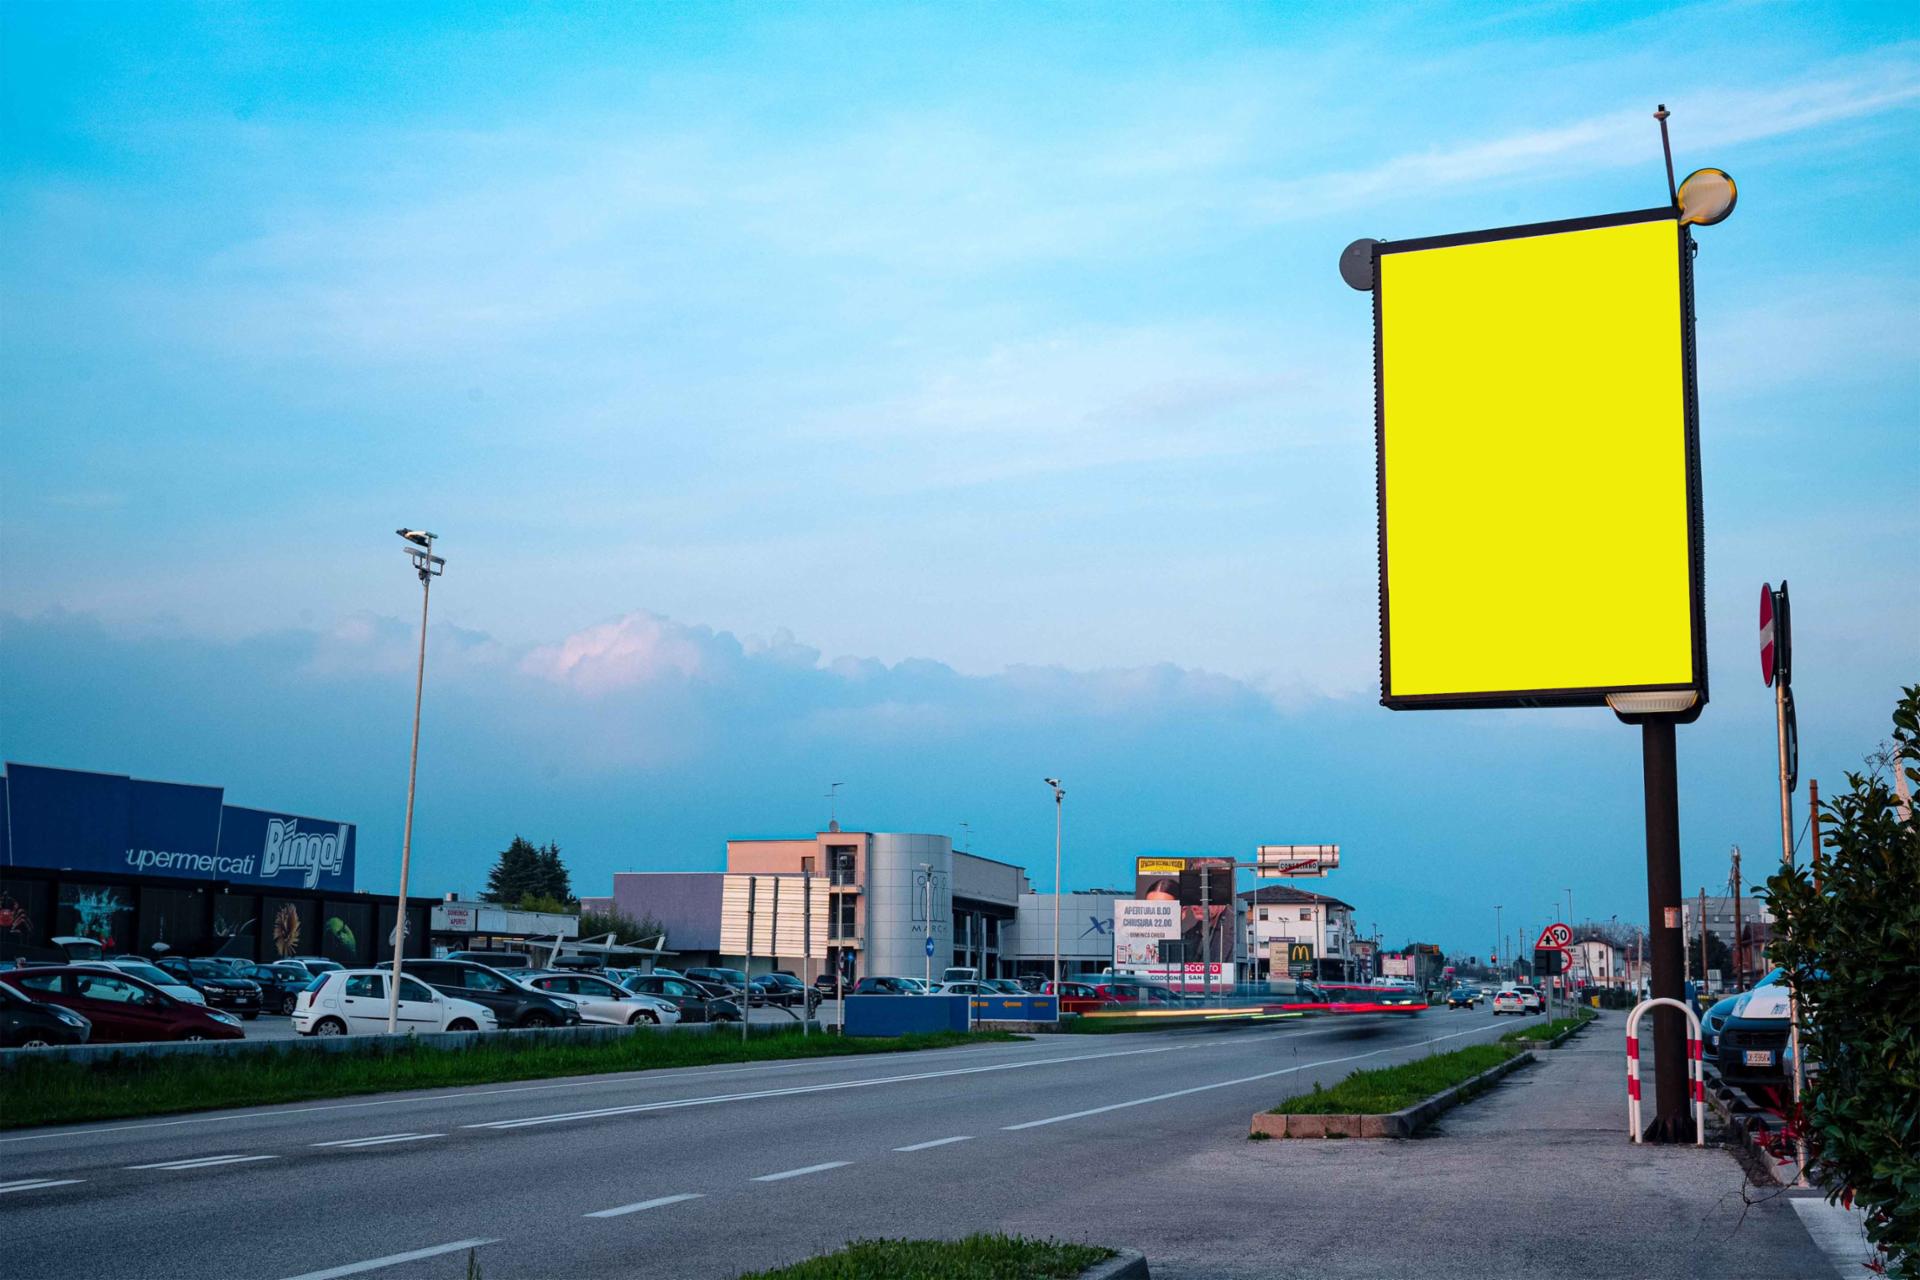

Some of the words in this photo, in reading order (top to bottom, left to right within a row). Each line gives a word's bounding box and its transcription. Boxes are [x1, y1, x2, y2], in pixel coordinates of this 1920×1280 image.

[260, 818, 349, 890] Bingo!
[125, 849, 255, 875] upermercati
[1124, 906, 1156, 916] APERTURA
[1123, 918, 1154, 928] CHIUSURA
[1154, 918, 1172, 928] 22.00
[1553, 929, 1567, 941] 50
